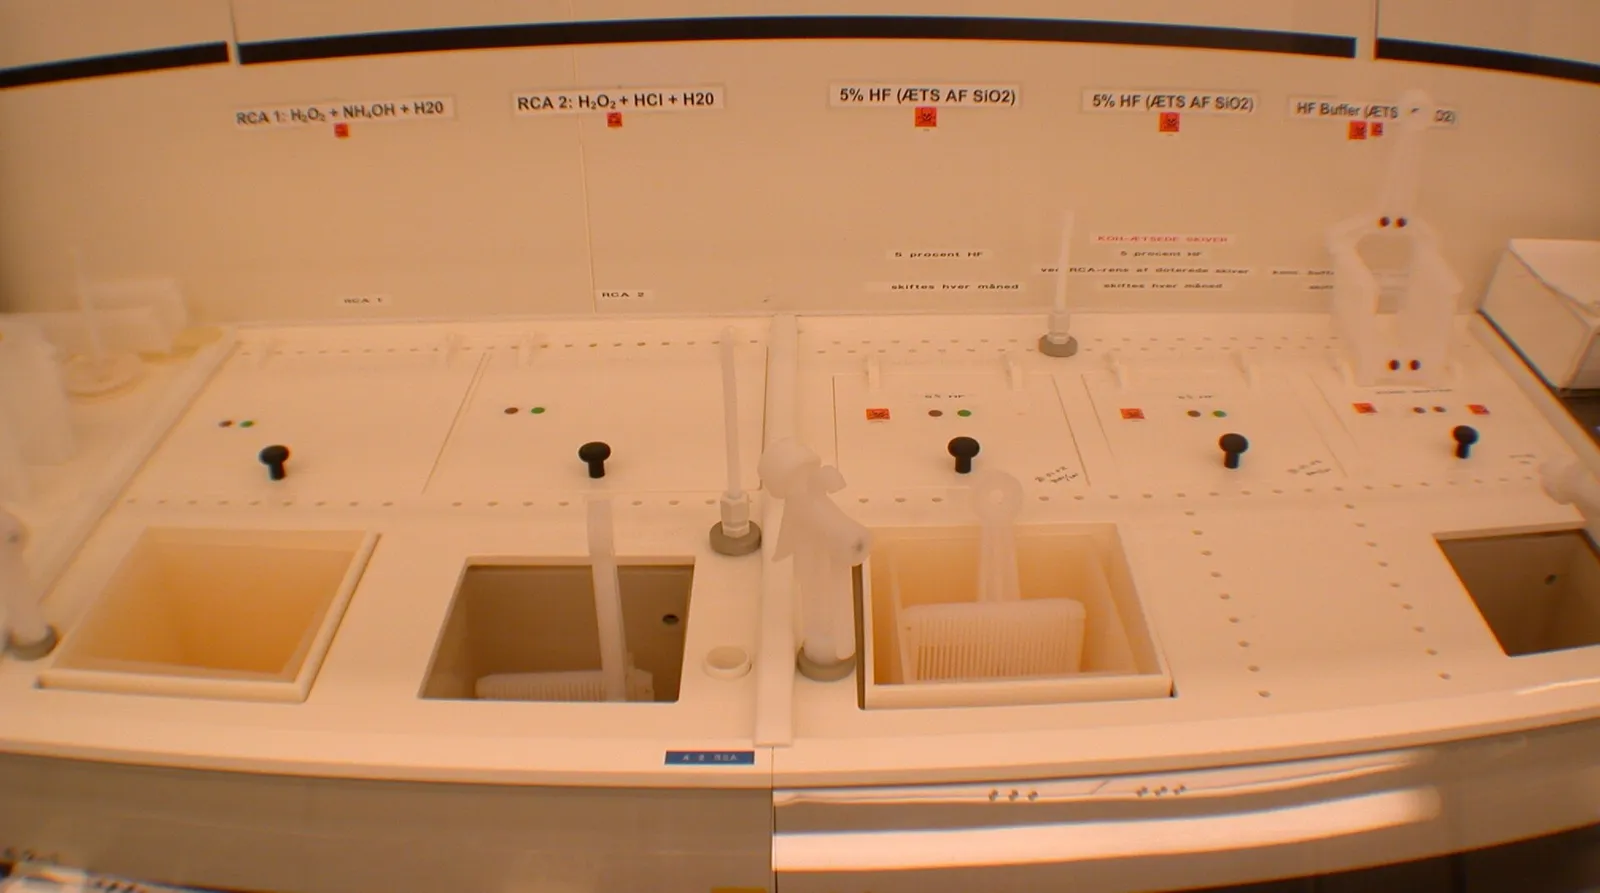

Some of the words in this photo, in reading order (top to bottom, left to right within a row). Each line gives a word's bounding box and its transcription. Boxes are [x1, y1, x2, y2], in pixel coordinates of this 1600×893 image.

[517, 97, 554, 110] RCA
[558, 96, 573, 109] 2:
[840, 88, 863, 101] 5%
[869, 88, 891, 102] HF
[897, 88, 940, 104] (ÆTS
[945, 89, 967, 103] AF
[973, 89, 1016, 105] SiO2)
[1092, 94, 1115, 107] 5%
[1120, 94, 1141, 107] HF
[1145, 94, 1185, 109] (ÆTS
[1190, 96, 1211, 109] AF
[1215, 96, 1254, 112] SiO2)
[1297, 102, 1316, 115] HF
[1320, 103, 1361, 116] Buffer
[236, 110, 270, 125] RCA
[274, 110, 286, 123] 1:
[910, 251, 960, 259] procent
